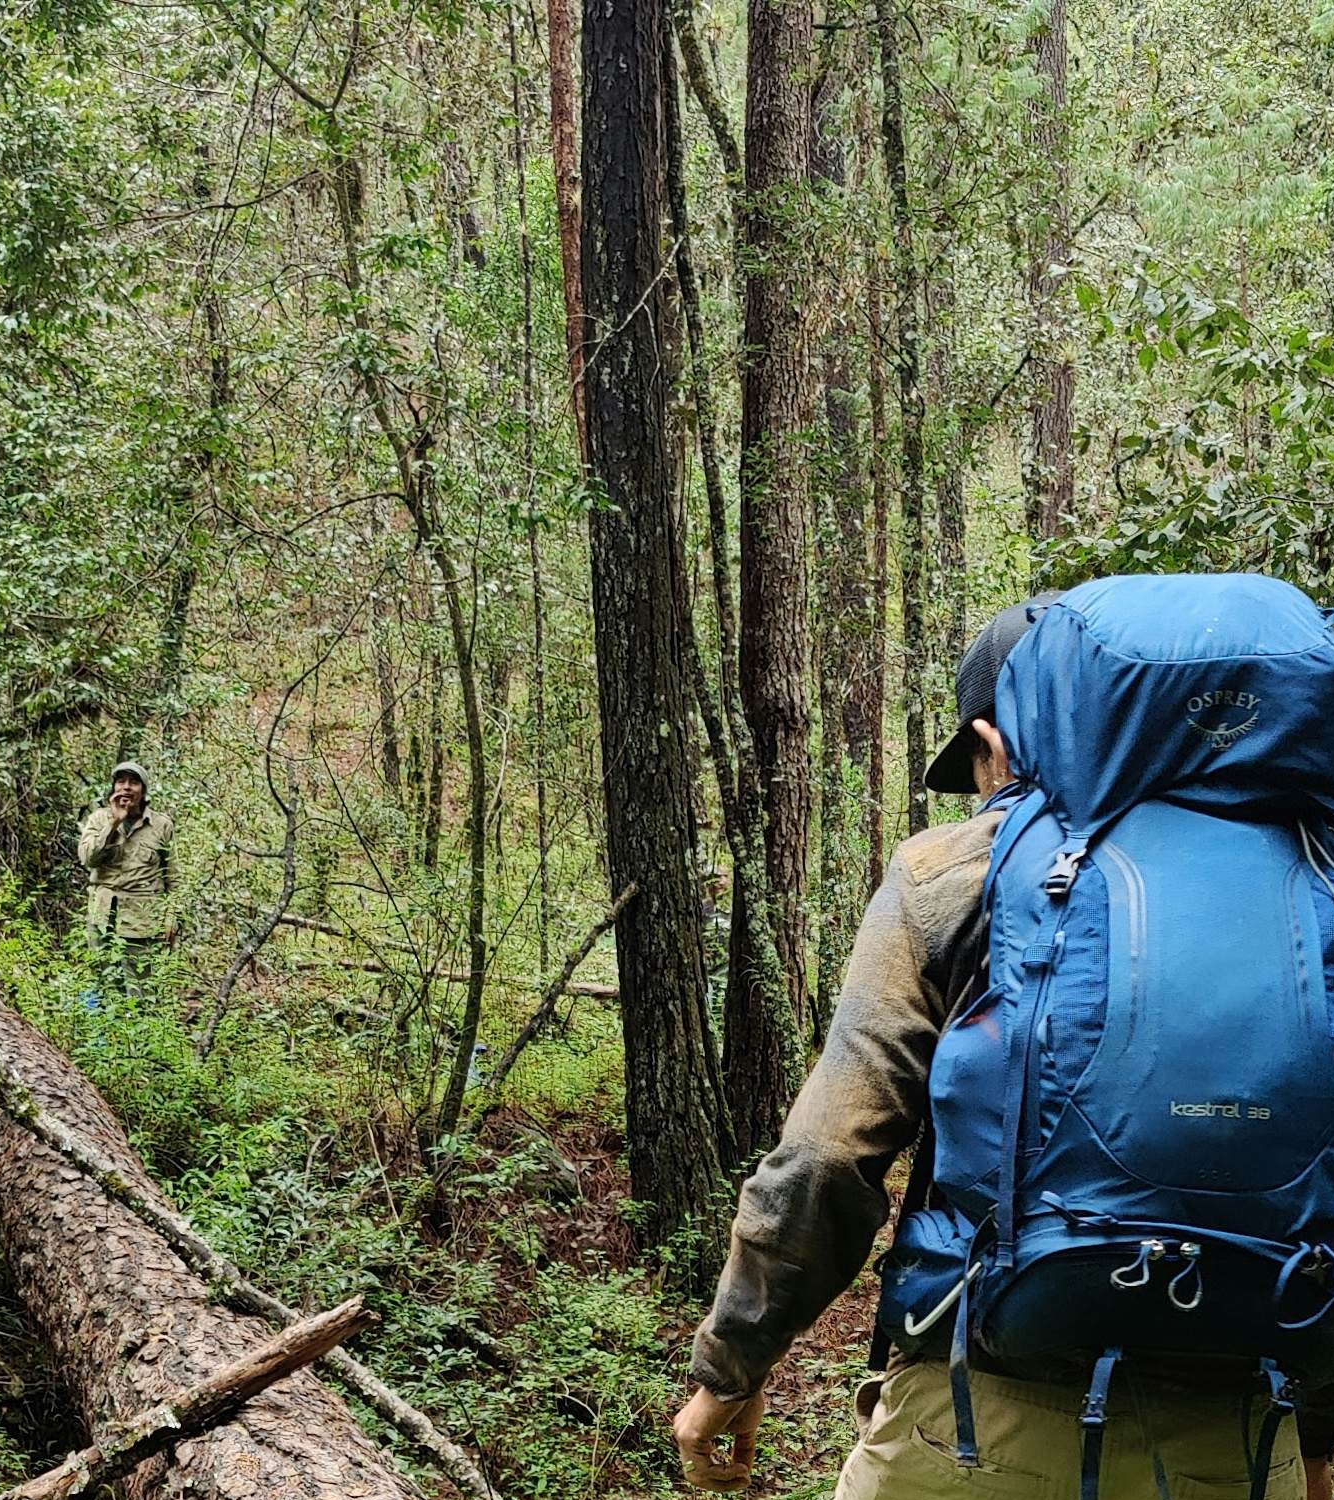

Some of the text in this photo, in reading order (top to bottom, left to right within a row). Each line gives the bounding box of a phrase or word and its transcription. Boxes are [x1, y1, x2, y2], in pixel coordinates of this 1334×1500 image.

[1187, 690, 1262, 712] OSPREY
[1170, 1100, 1271, 1120] kestrel 38
